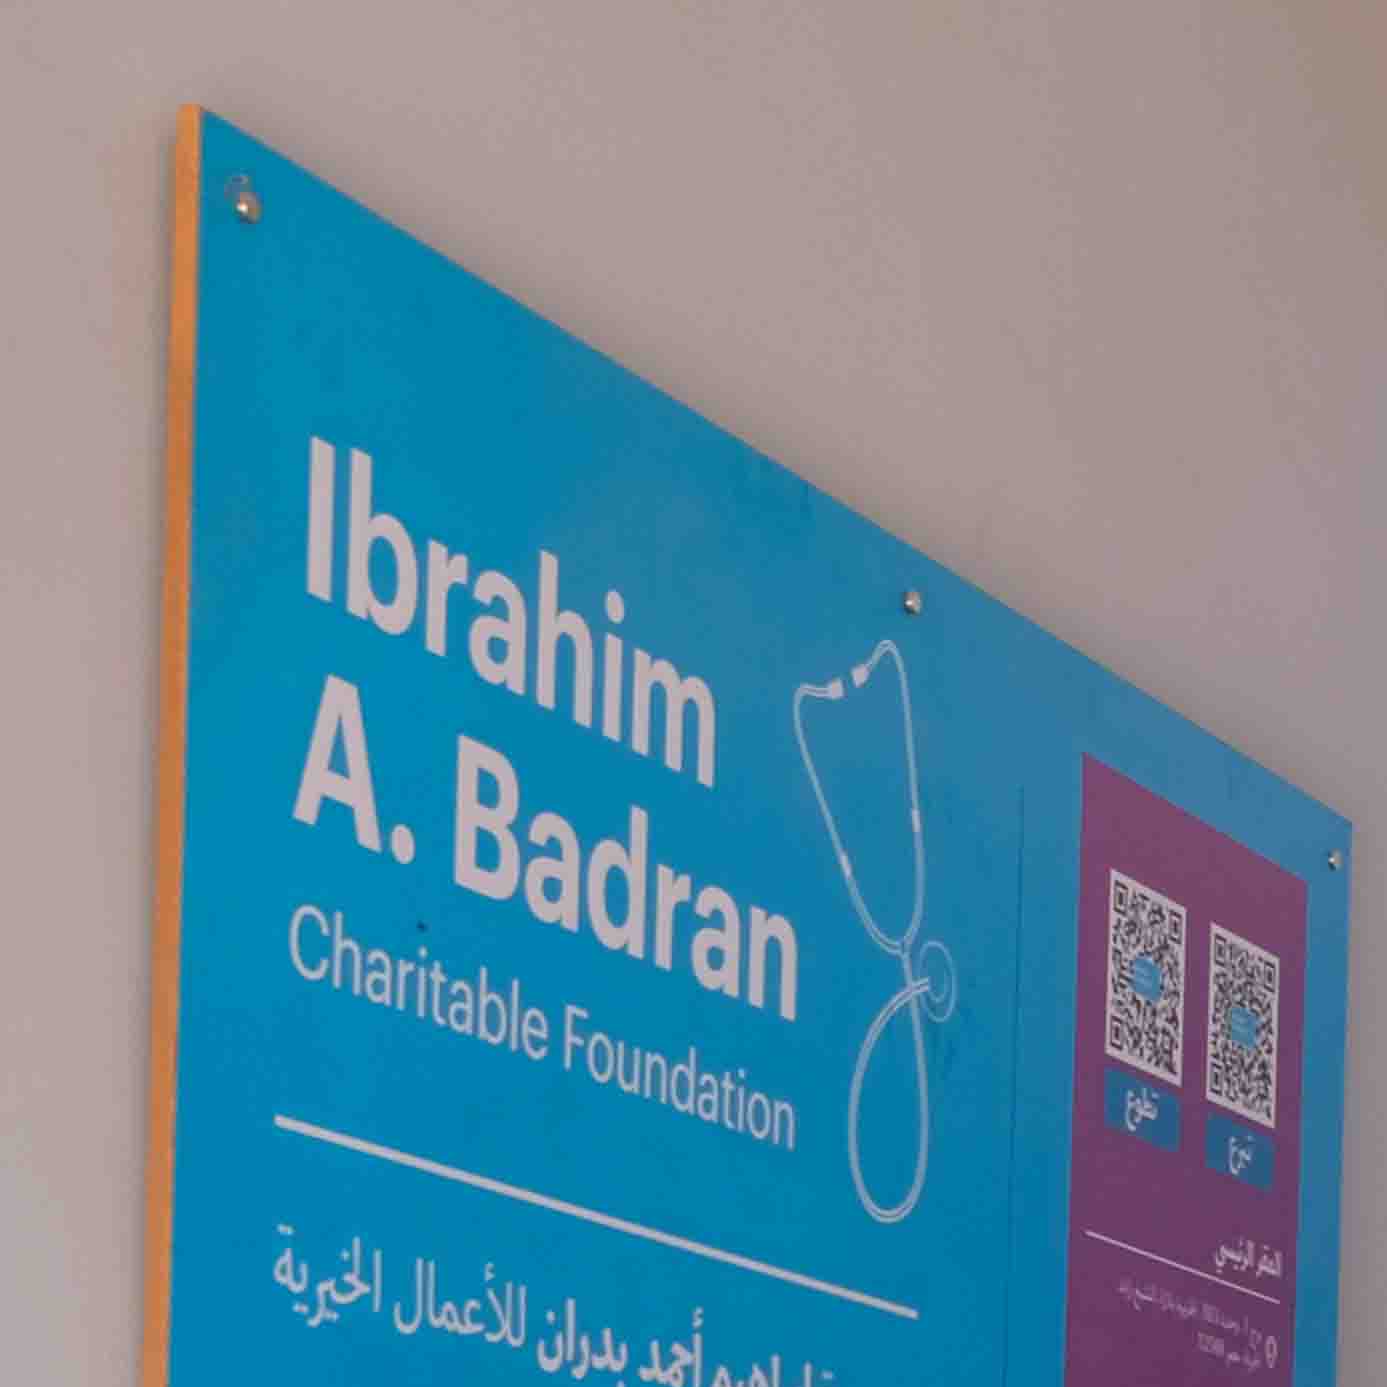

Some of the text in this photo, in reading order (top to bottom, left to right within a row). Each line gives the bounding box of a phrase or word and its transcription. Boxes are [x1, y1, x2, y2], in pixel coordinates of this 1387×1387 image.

[307, 435, 716, 790] Ibrahim
[292, 673, 797, 1023] A. Badran
[289, 905, 795, 1150] Charitable Foundation
[274, 1223, 382, 1326] الخيرية
[394, 1257, 527, 1347] للأعمال
